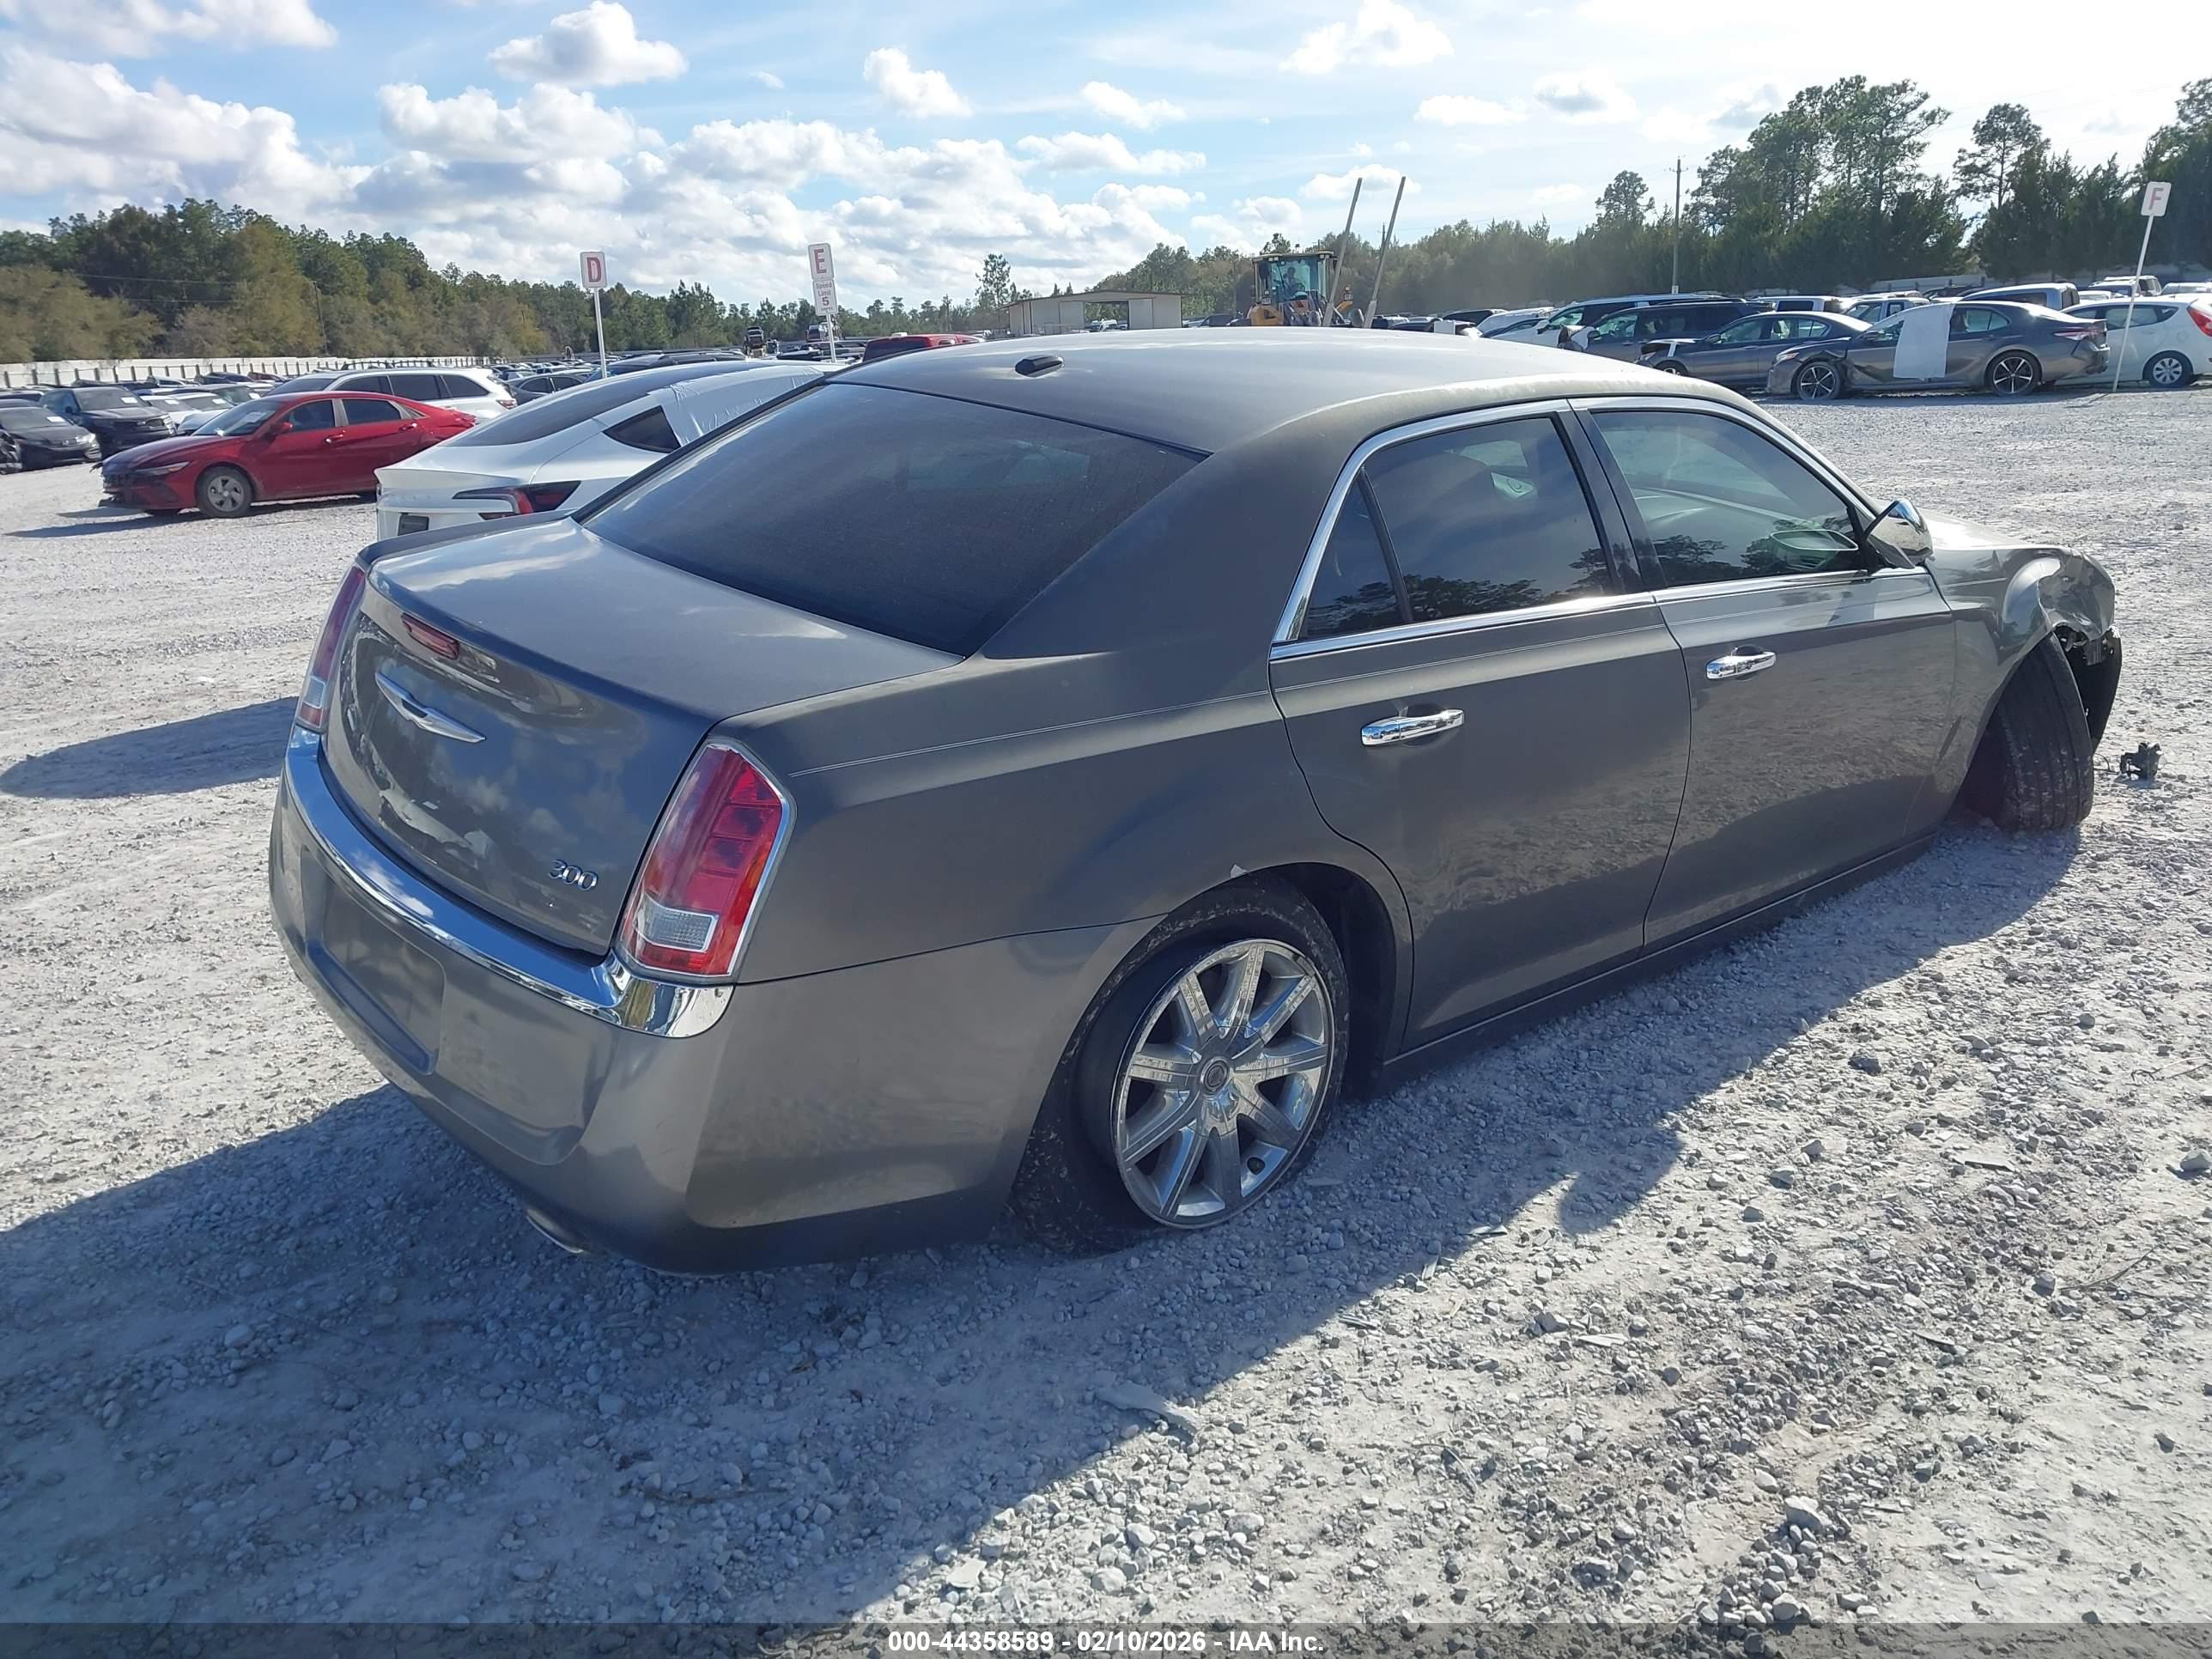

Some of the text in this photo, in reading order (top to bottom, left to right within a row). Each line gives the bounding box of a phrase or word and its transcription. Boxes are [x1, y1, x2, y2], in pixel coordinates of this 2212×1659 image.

[2148, 187, 2165, 210] F
[586, 257, 602, 283] D
[813, 248, 827, 274] E
[822, 296, 830, 307] 5
[547, 859, 598, 890] 300
